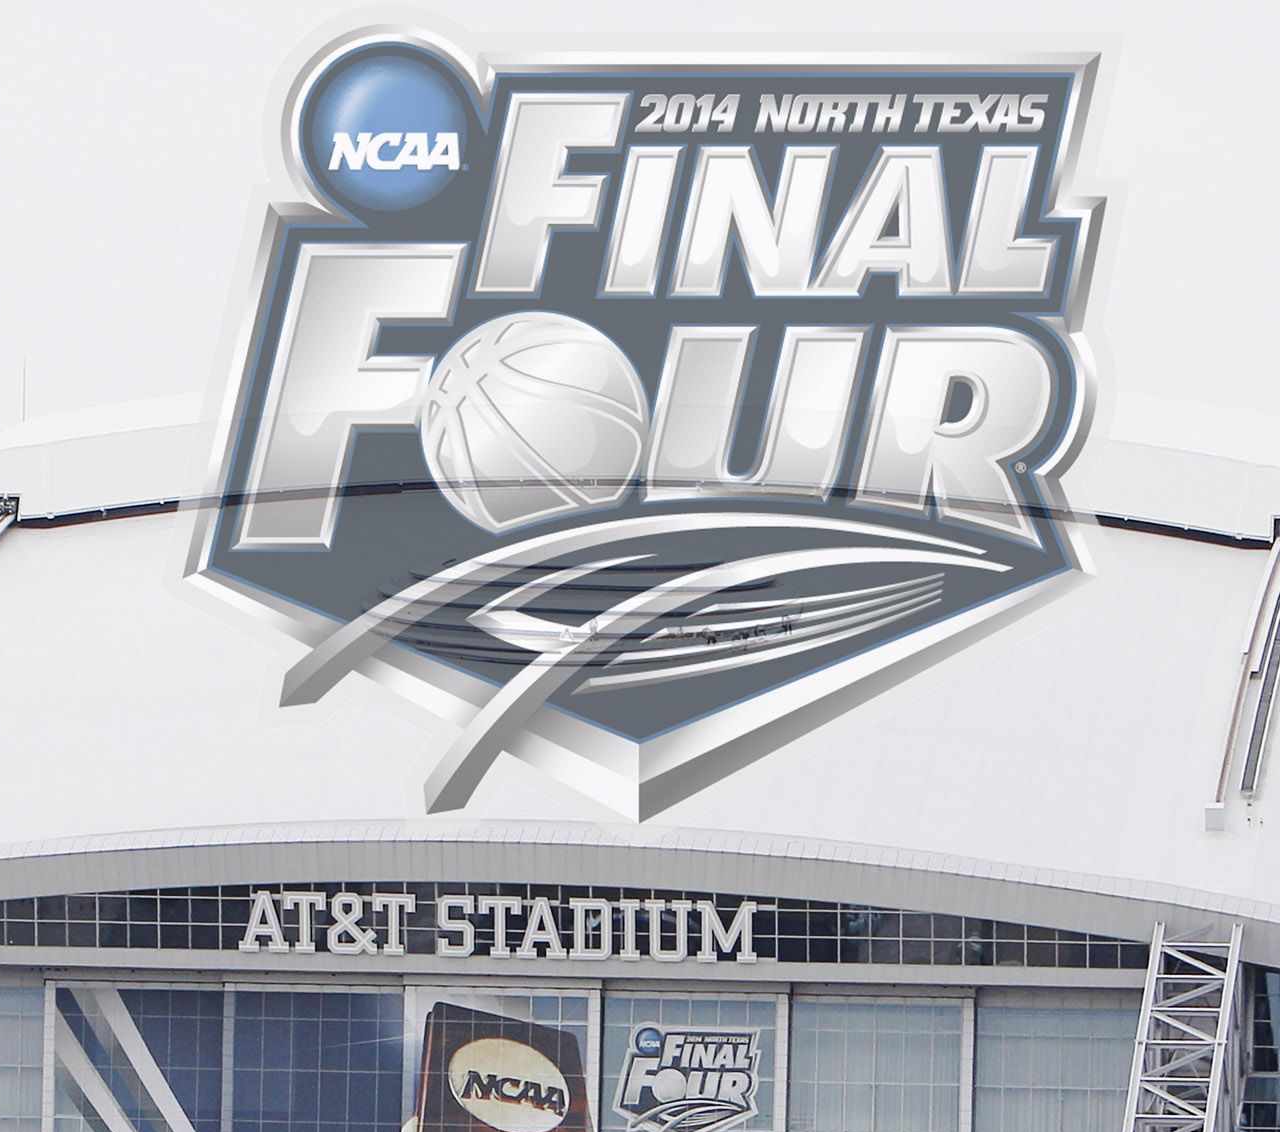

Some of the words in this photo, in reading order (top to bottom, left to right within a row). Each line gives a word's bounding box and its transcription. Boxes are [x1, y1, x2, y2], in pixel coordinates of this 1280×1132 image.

[238, 890, 417, 956] AT&T
[437, 894, 758, 964] STADIUM
[638, 1040, 660, 1048] NCAA
[661, 1035, 752, 1069] FINAL
[461, 1070, 566, 1116] NCAA
[623, 1057, 749, 1106] FOUR
